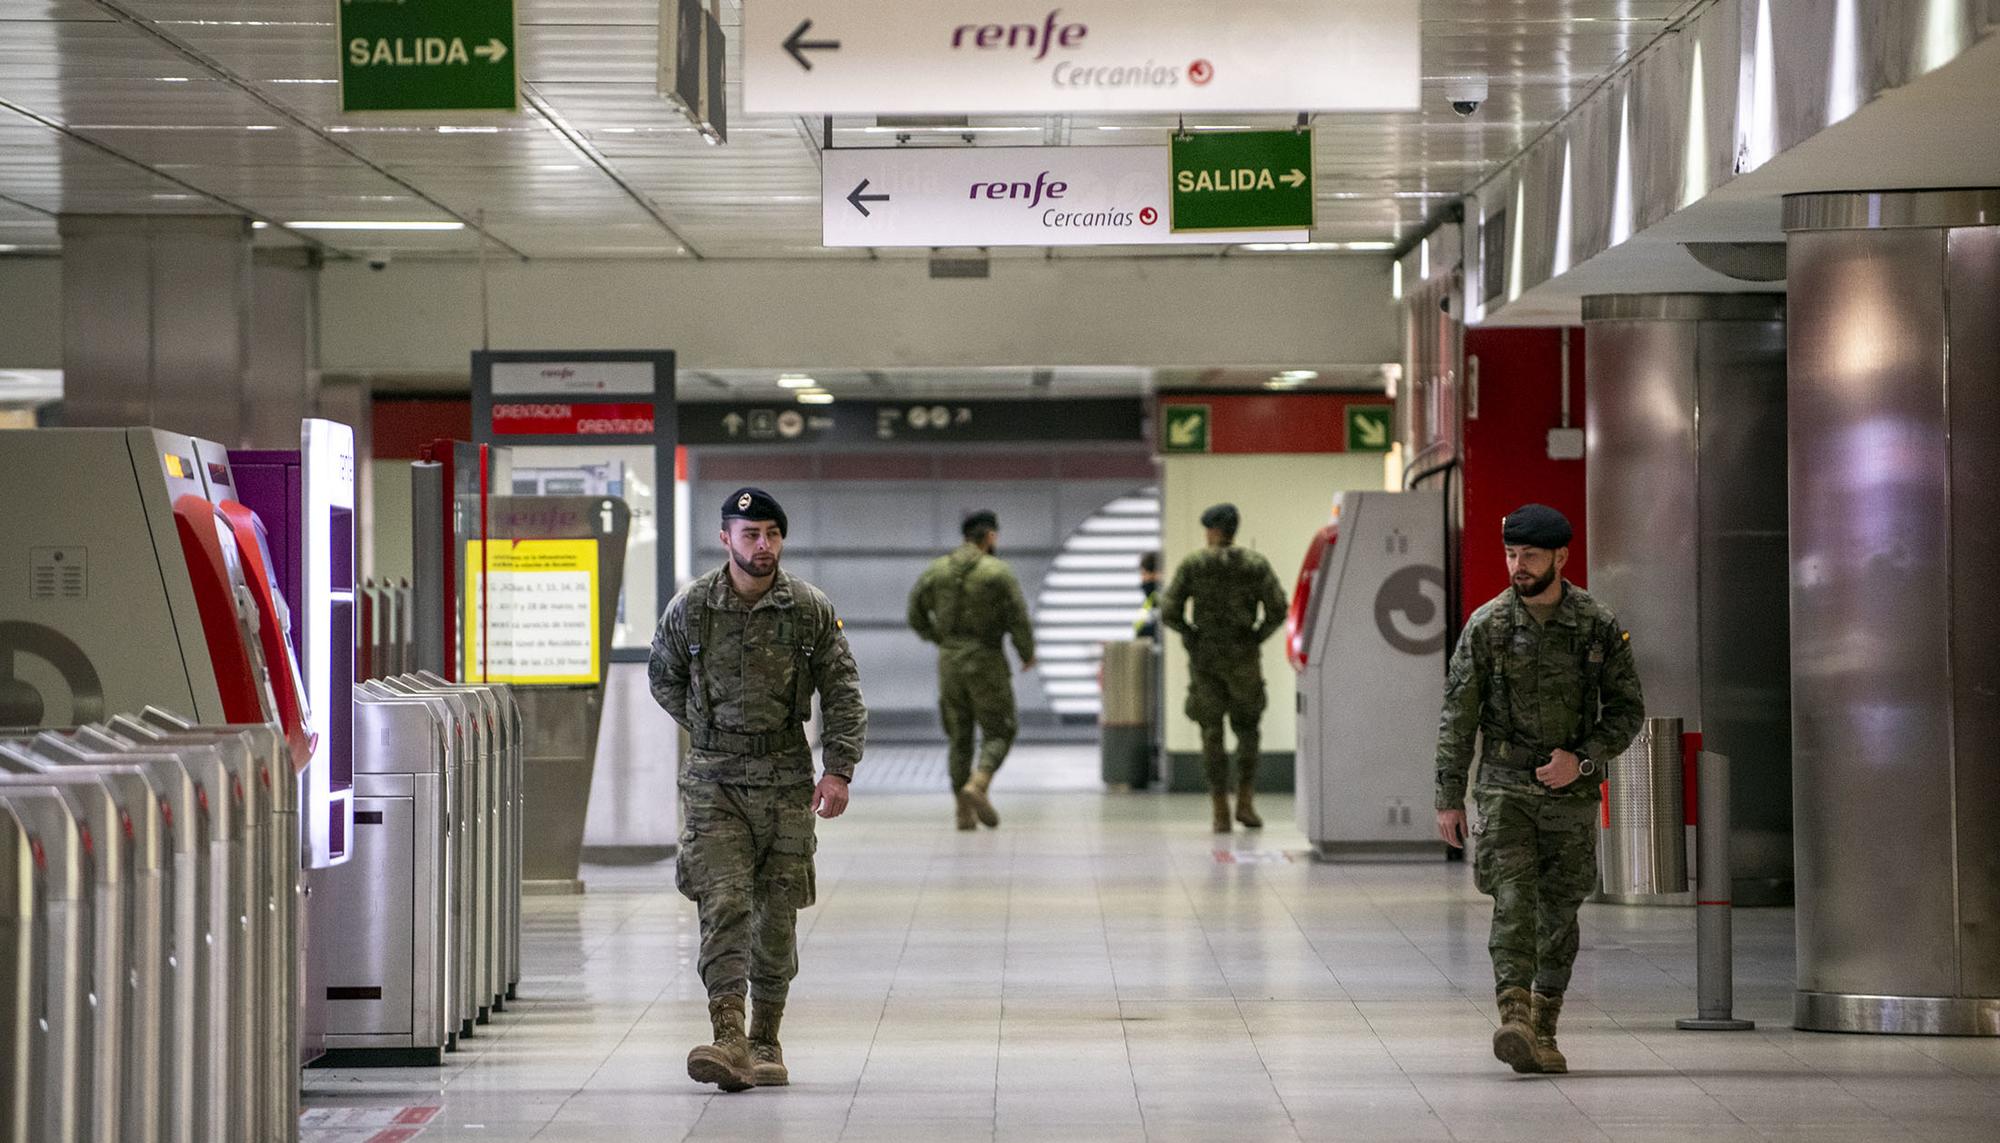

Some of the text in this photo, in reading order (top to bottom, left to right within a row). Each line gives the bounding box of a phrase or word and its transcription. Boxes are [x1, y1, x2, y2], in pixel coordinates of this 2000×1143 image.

[950, 9, 1089, 60] renfe
[349, 37, 469, 66] SALIDA
[1052, 58, 1179, 88] Cercanías
[969, 170, 1067, 208] renfe
[1177, 168, 1275, 193] SALIDA
[1043, 207, 1133, 228] Cercanías
